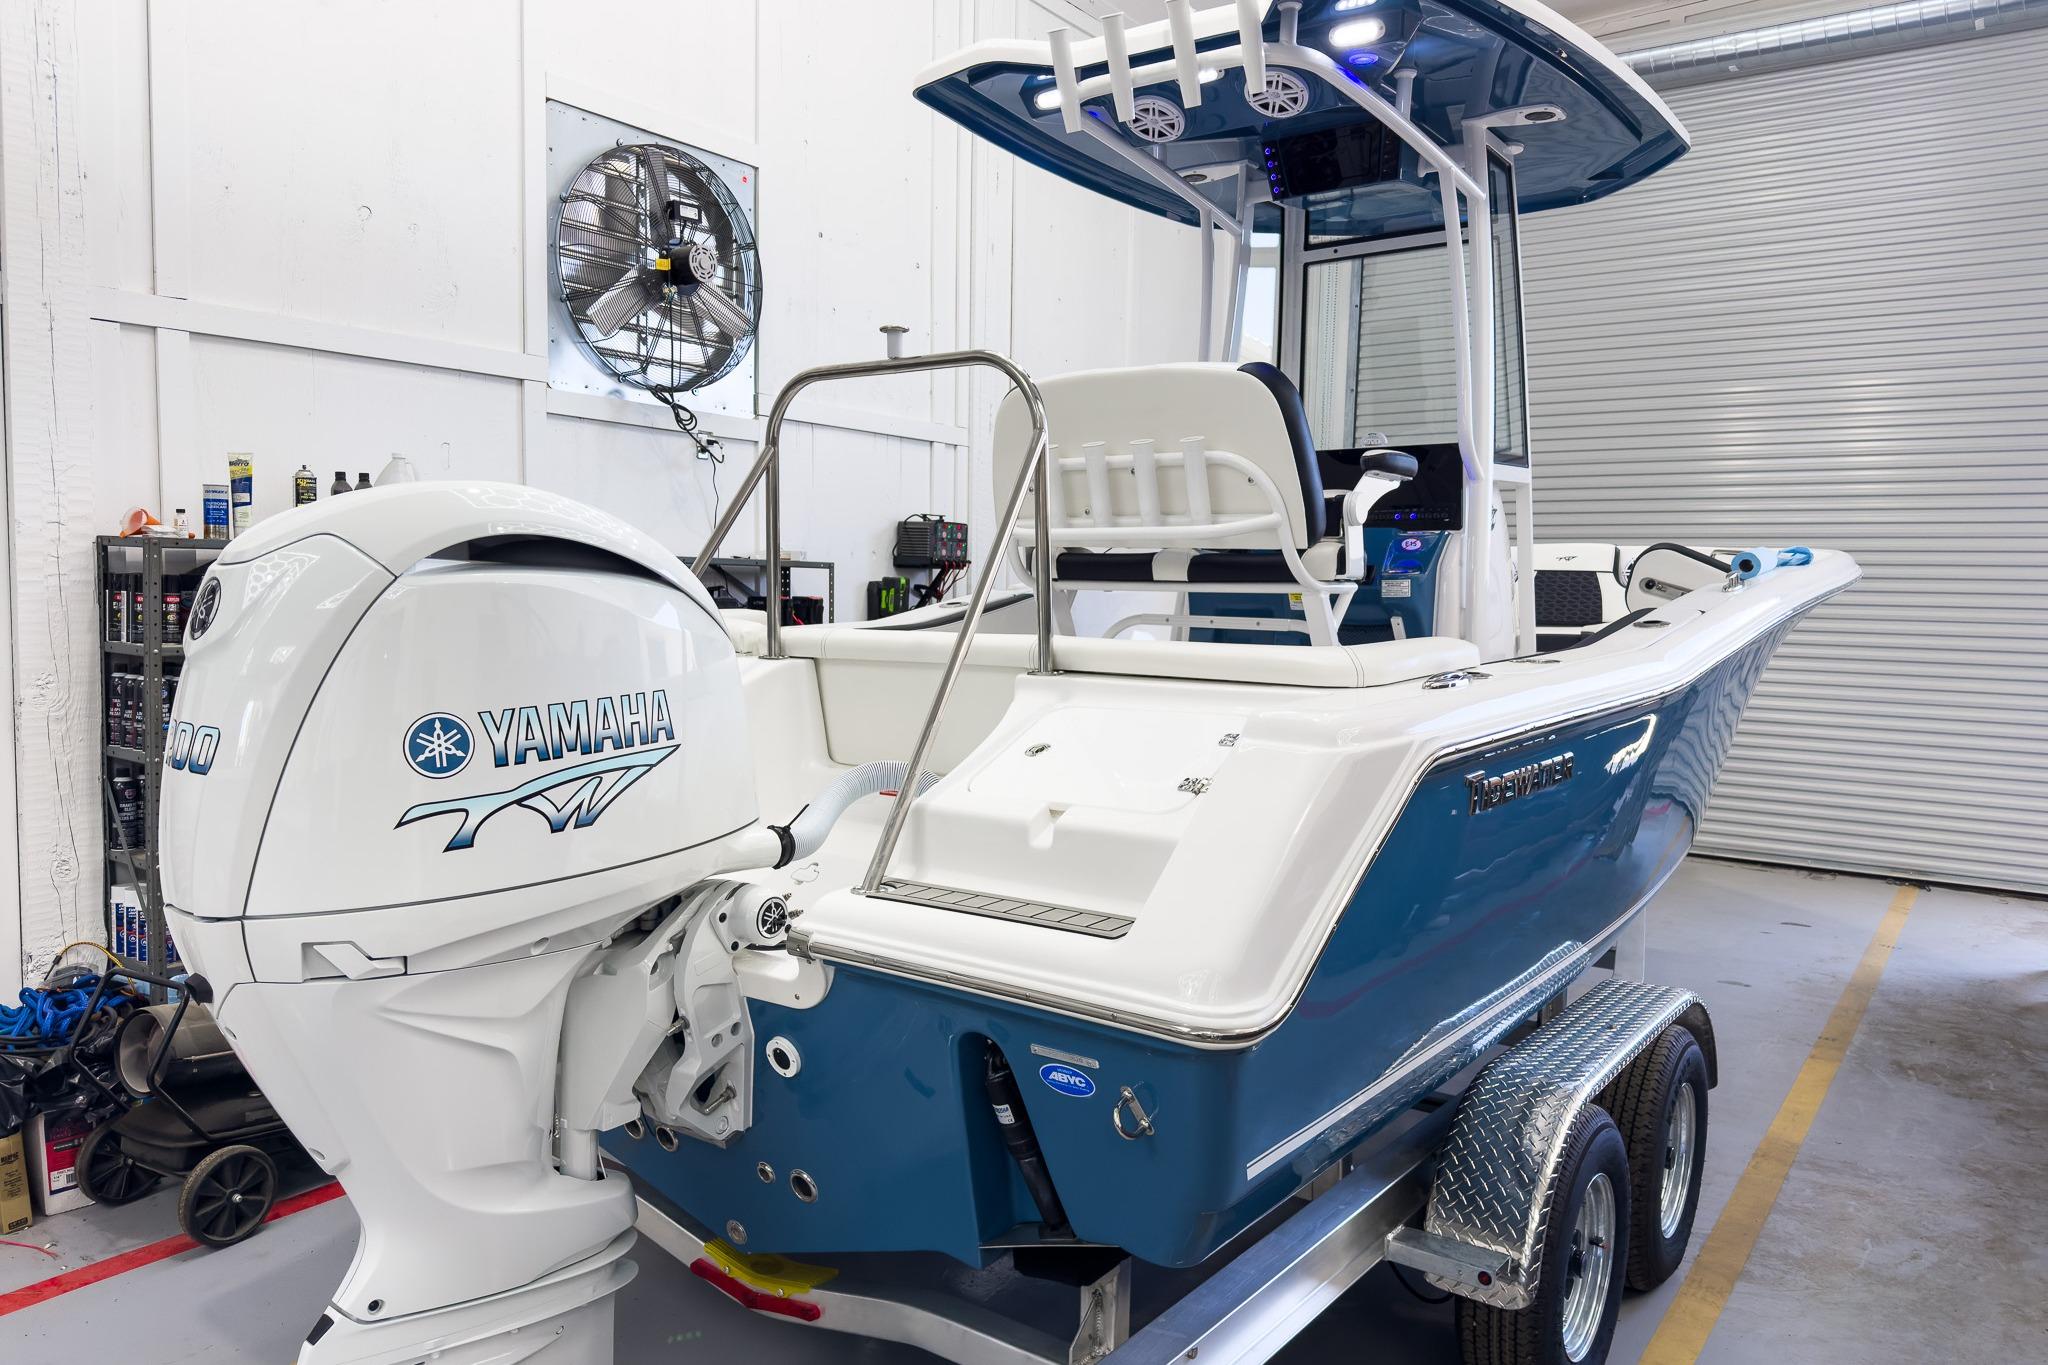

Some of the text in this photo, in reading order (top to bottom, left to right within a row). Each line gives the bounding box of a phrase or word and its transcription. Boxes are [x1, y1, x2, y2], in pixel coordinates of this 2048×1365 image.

[165, 718, 220, 775] 00
[477, 689, 675, 768] YAMAHA
[1464, 751, 1574, 816] TIDEWATER
[1048, 1071, 1087, 1088] ABYC
